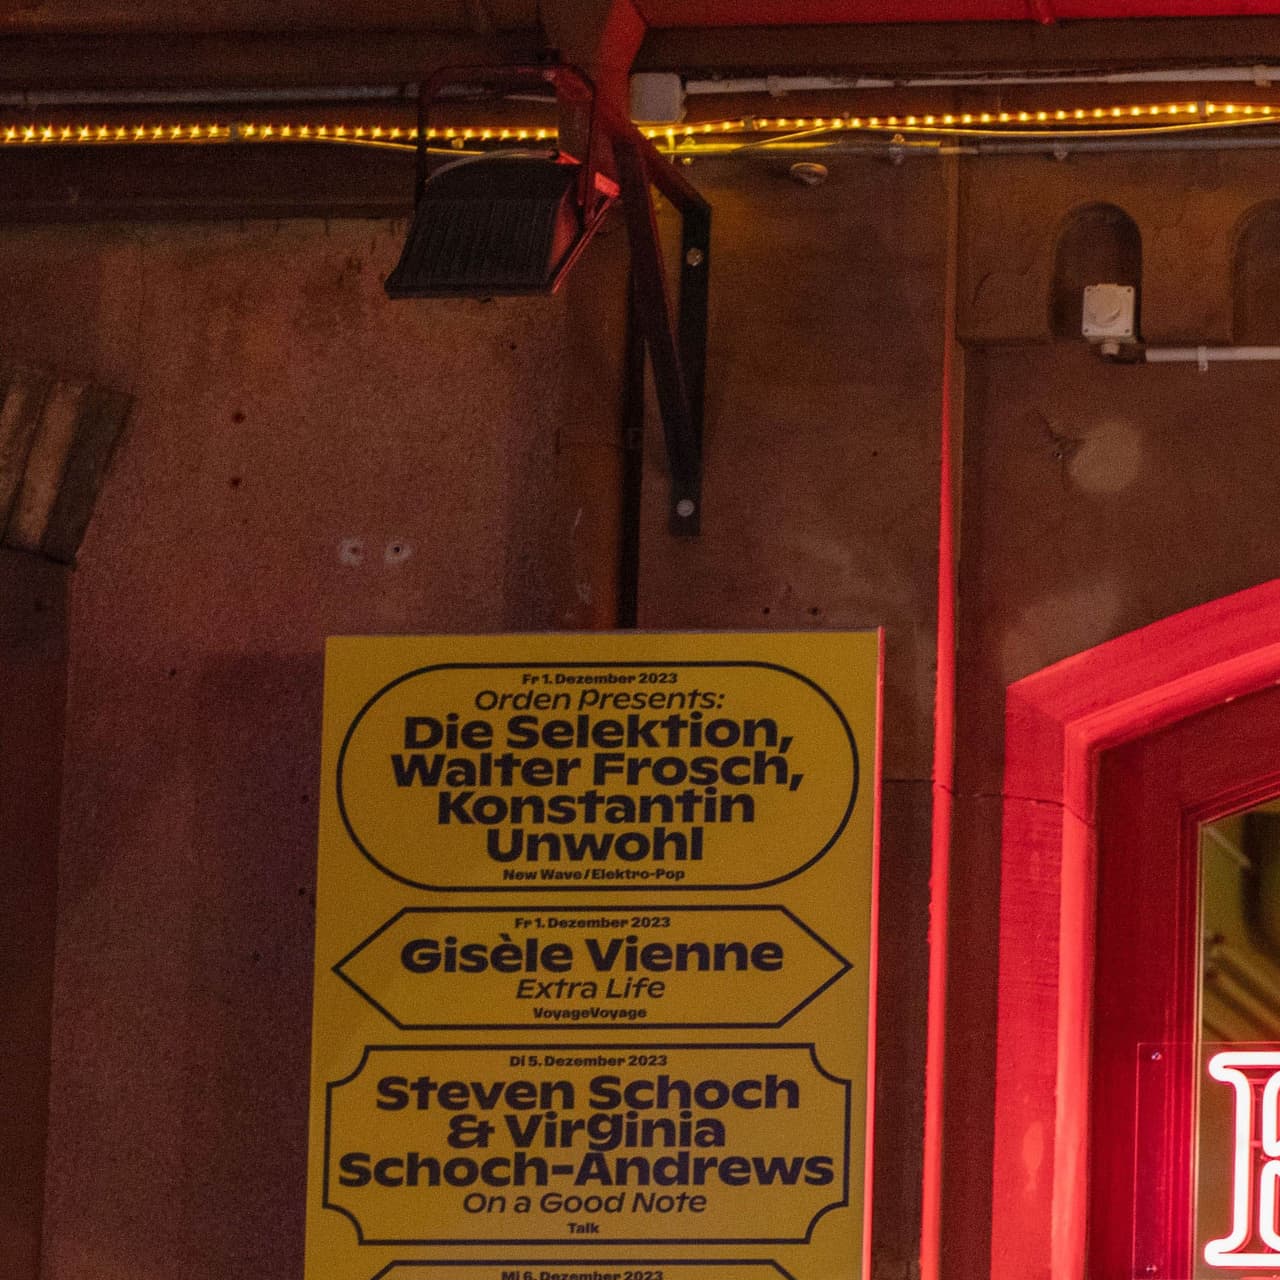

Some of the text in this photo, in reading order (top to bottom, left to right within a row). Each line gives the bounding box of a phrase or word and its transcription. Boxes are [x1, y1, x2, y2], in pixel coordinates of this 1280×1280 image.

[522, 673, 677, 684] Fr 1. Dezember 2023
[475, 690, 570, 711] Orden
[404, 714, 792, 753] Die Selektion,
[391, 751, 804, 791] Walter Frosch,
[438, 787, 754, 824] Konstantin
[487, 826, 703, 862] Unwohl
[503, 869, 537, 880] New
[515, 916, 670, 928] Fr 1. Dezember 2023
[401, 934, 783, 973] Gisèle Vienne
[516, 977, 665, 999] Extra Life
[533, 1008, 646, 1021] VoyageVoyage
[510, 1055, 667, 1066] Di 5. Dezember 2023
[376, 1075, 800, 1111] Steven Schoch
[448, 1111, 725, 1152] & Virginia
[339, 1151, 834, 1187] Schoch-Andrews
[464, 1191, 706, 1213] On a Good Note
[568, 1223, 599, 1233] Talk
